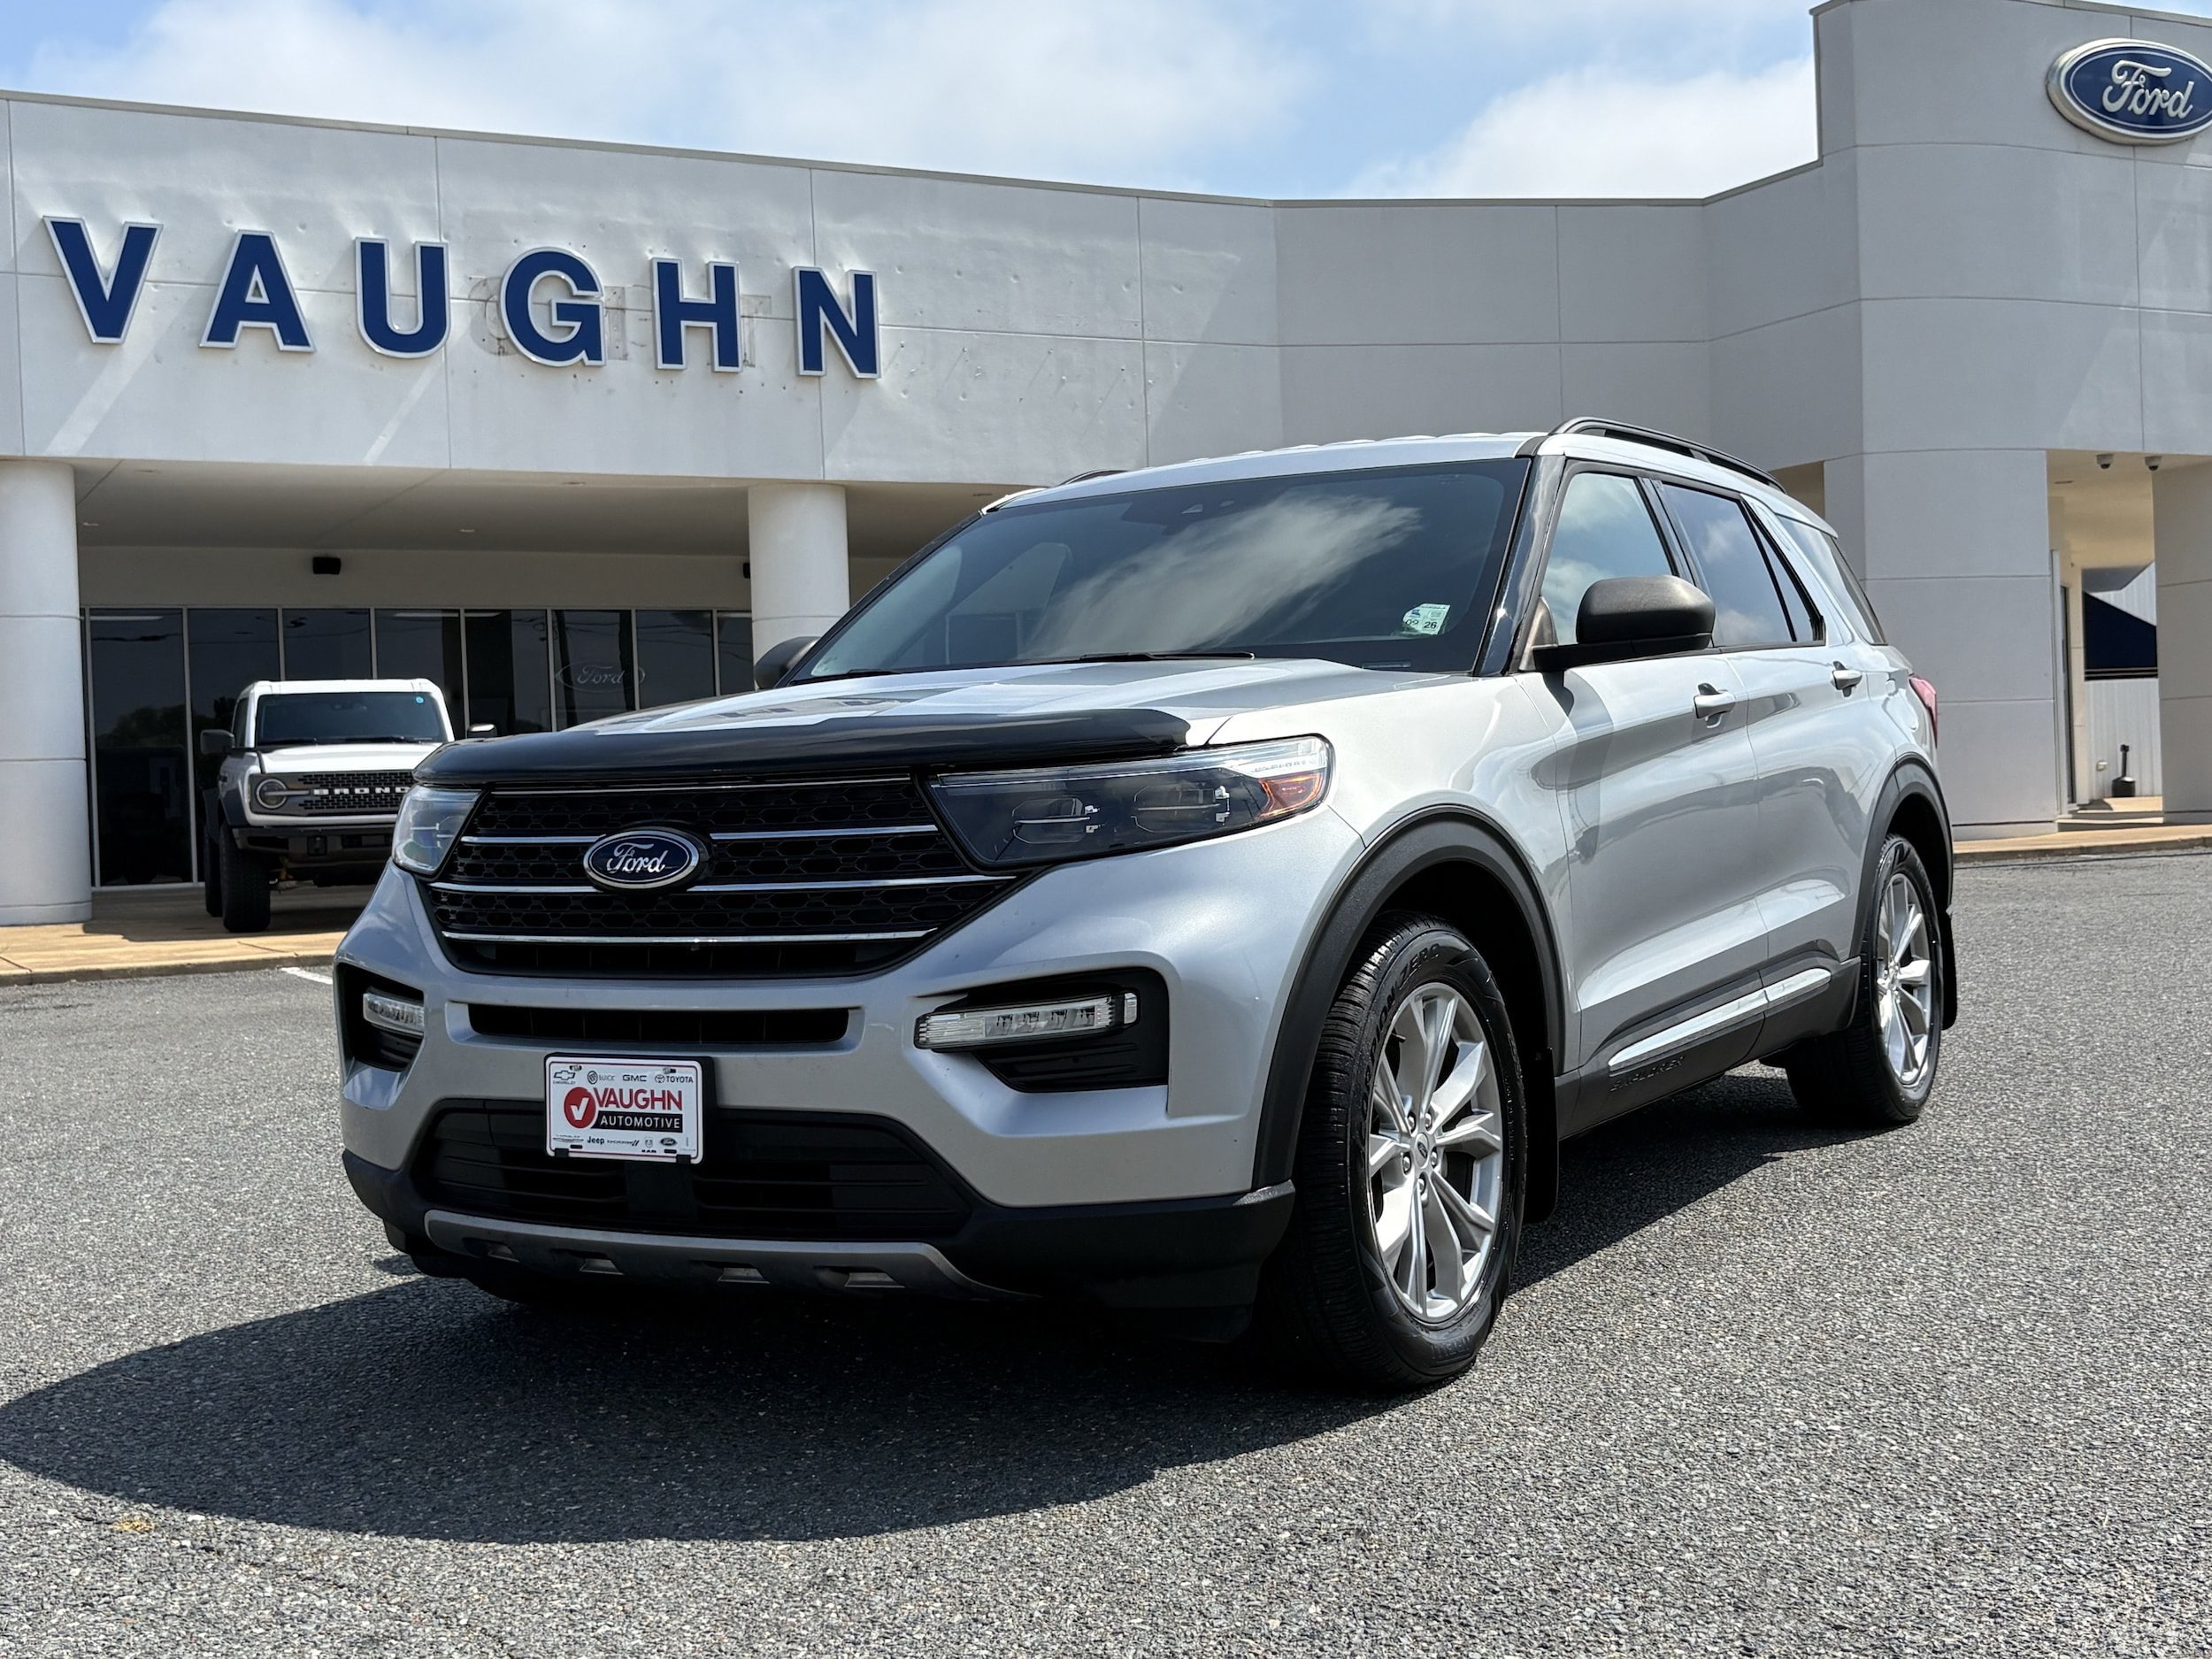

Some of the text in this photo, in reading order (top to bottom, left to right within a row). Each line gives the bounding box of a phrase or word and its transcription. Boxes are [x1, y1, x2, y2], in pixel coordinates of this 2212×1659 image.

[2102, 60, 2194, 119] Ford
[42, 215, 882, 380] VAUGHN
[577, 665, 625, 685] Ford
[313, 787, 411, 795] BRONC
[607, 842, 669, 873] Ford
[665, 1075, 694, 1084] TOYOTA
[594, 1087, 683, 1111] VAUGHN
[600, 1115, 680, 1129] AUTOMOTIVE
[587, 1136, 605, 1145] Jeep
